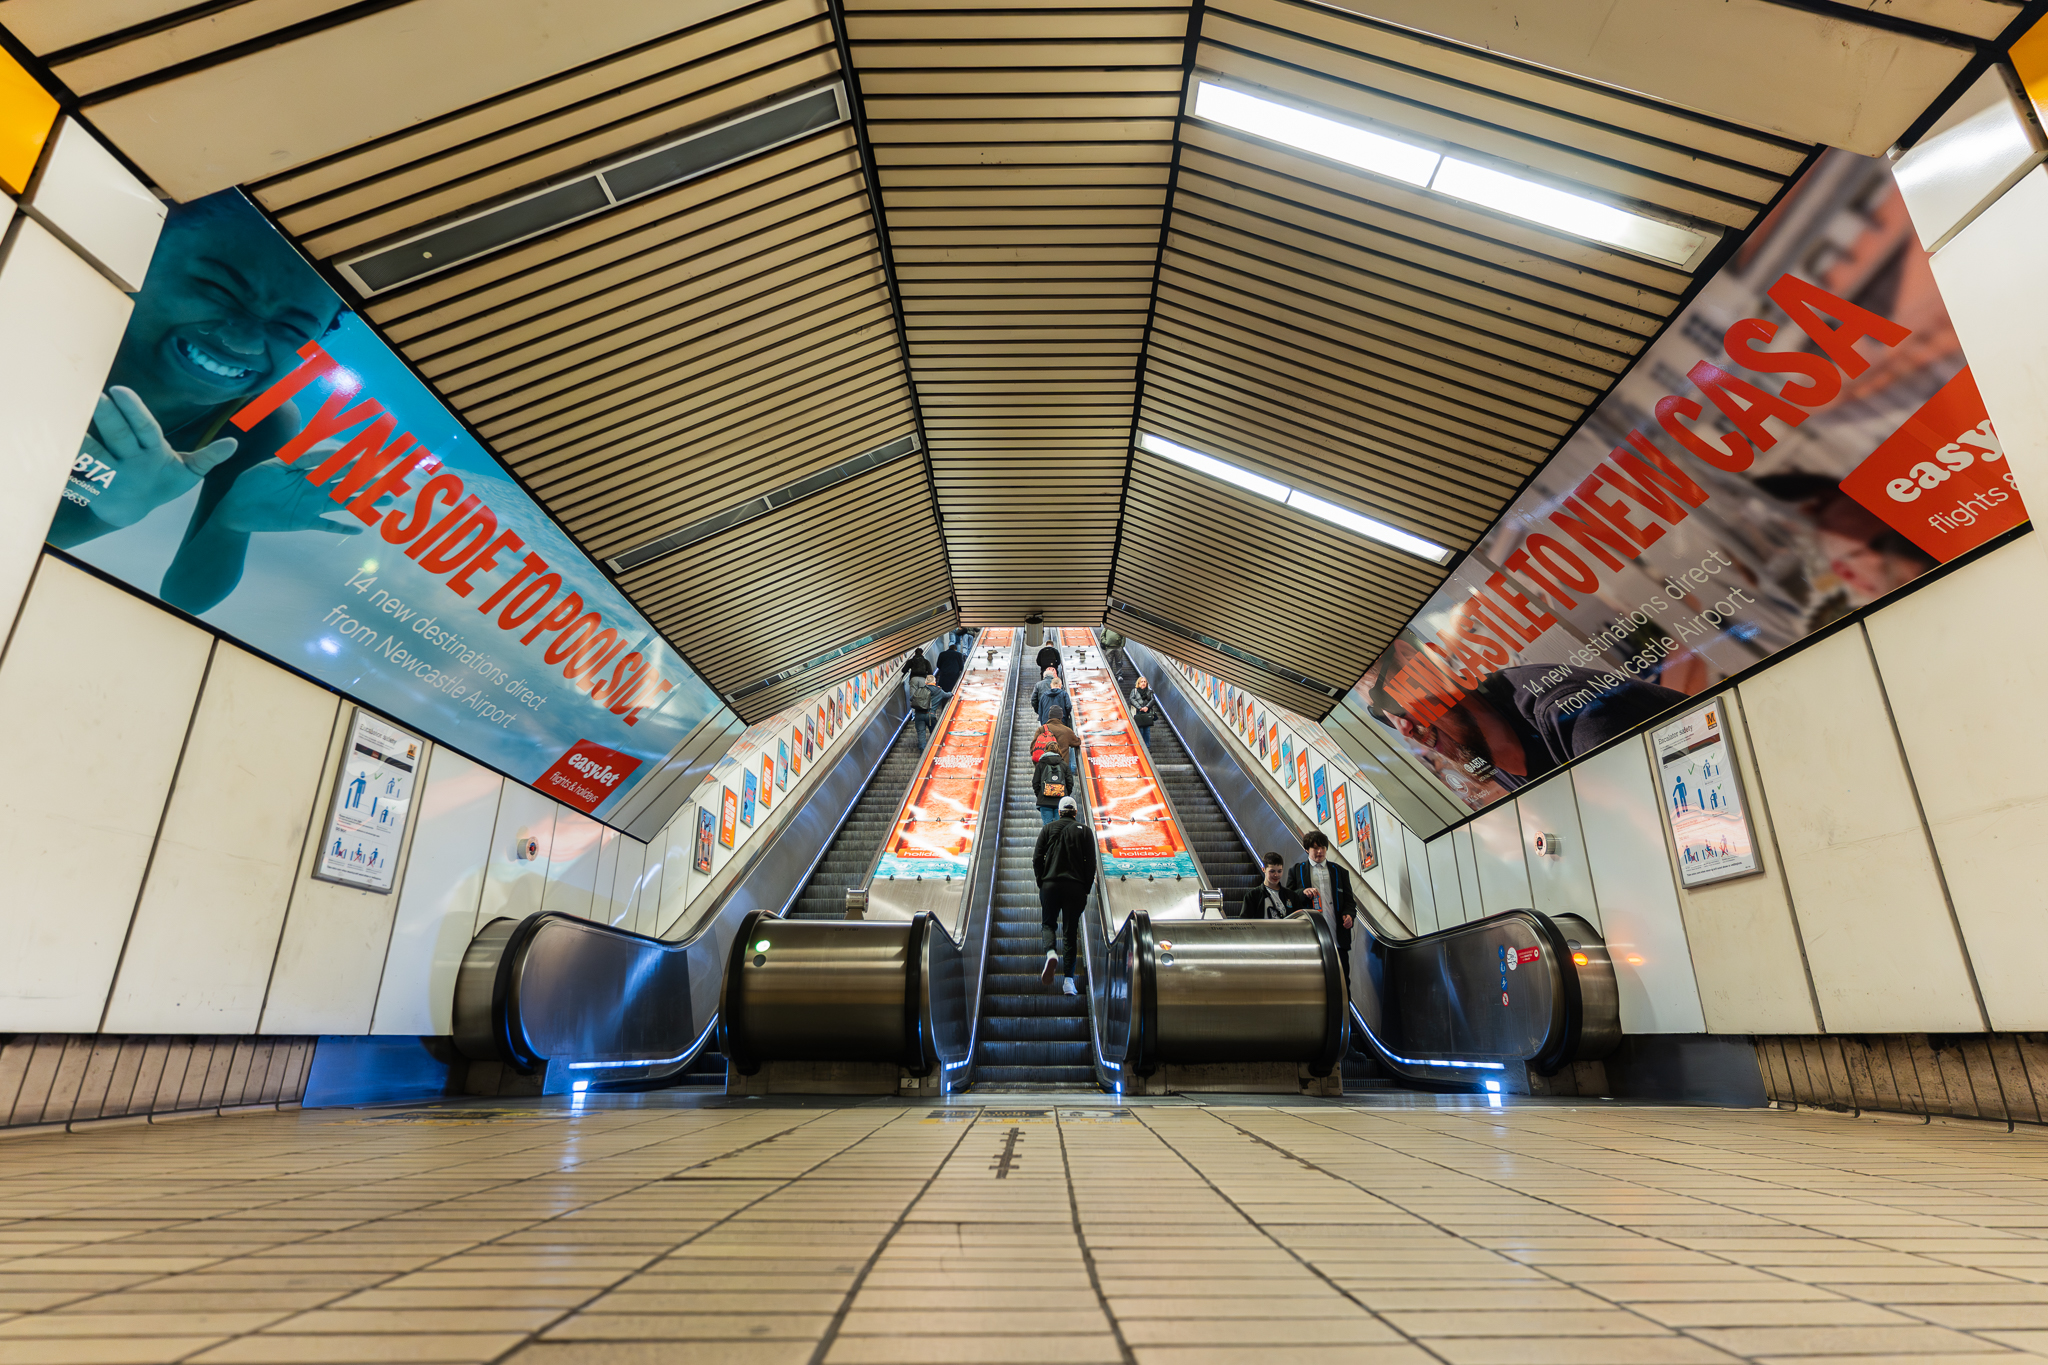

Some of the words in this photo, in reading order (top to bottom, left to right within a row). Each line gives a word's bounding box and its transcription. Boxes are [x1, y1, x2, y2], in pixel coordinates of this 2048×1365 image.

[1654, 272, 1913, 473] CASA
[62, 488, 91, 507] 6633
[72, 452, 117, 489] BTA
[229, 339, 526, 599] TYNESIDE
[1548, 428, 1710, 573] NEW
[1886, 419, 2004, 503] easy
[1928, 487, 2009, 534] flights
[477, 551, 562, 630] TO
[1504, 533, 1599, 611] TO
[1522, 679, 1546, 698] 14
[1540, 662, 1573, 691] new
[1569, 595, 1669, 668] destinations
[1664, 549, 1732, 600] direct
[322, 604, 378, 647] from
[374, 635, 467, 699] Newcastle
[461, 690, 517, 729] Airport
[344, 566, 378, 595] 14
[368, 588, 417, 623] new
[412, 616, 508, 686] destinations
[504, 678, 548, 711] direct
[519, 591, 674, 727] POOLSIDE
[1383, 570, 1558, 728] NEWCASTLE
[1555, 686, 1597, 716] from
[1587, 635, 1680, 695] Newcastle
[1673, 586, 1755, 643] Airport
[549, 771, 570, 789] flights
[568, 781, 578, 791] &
[573, 783, 599, 803] holidays
[568, 753, 620, 787] easyJet
